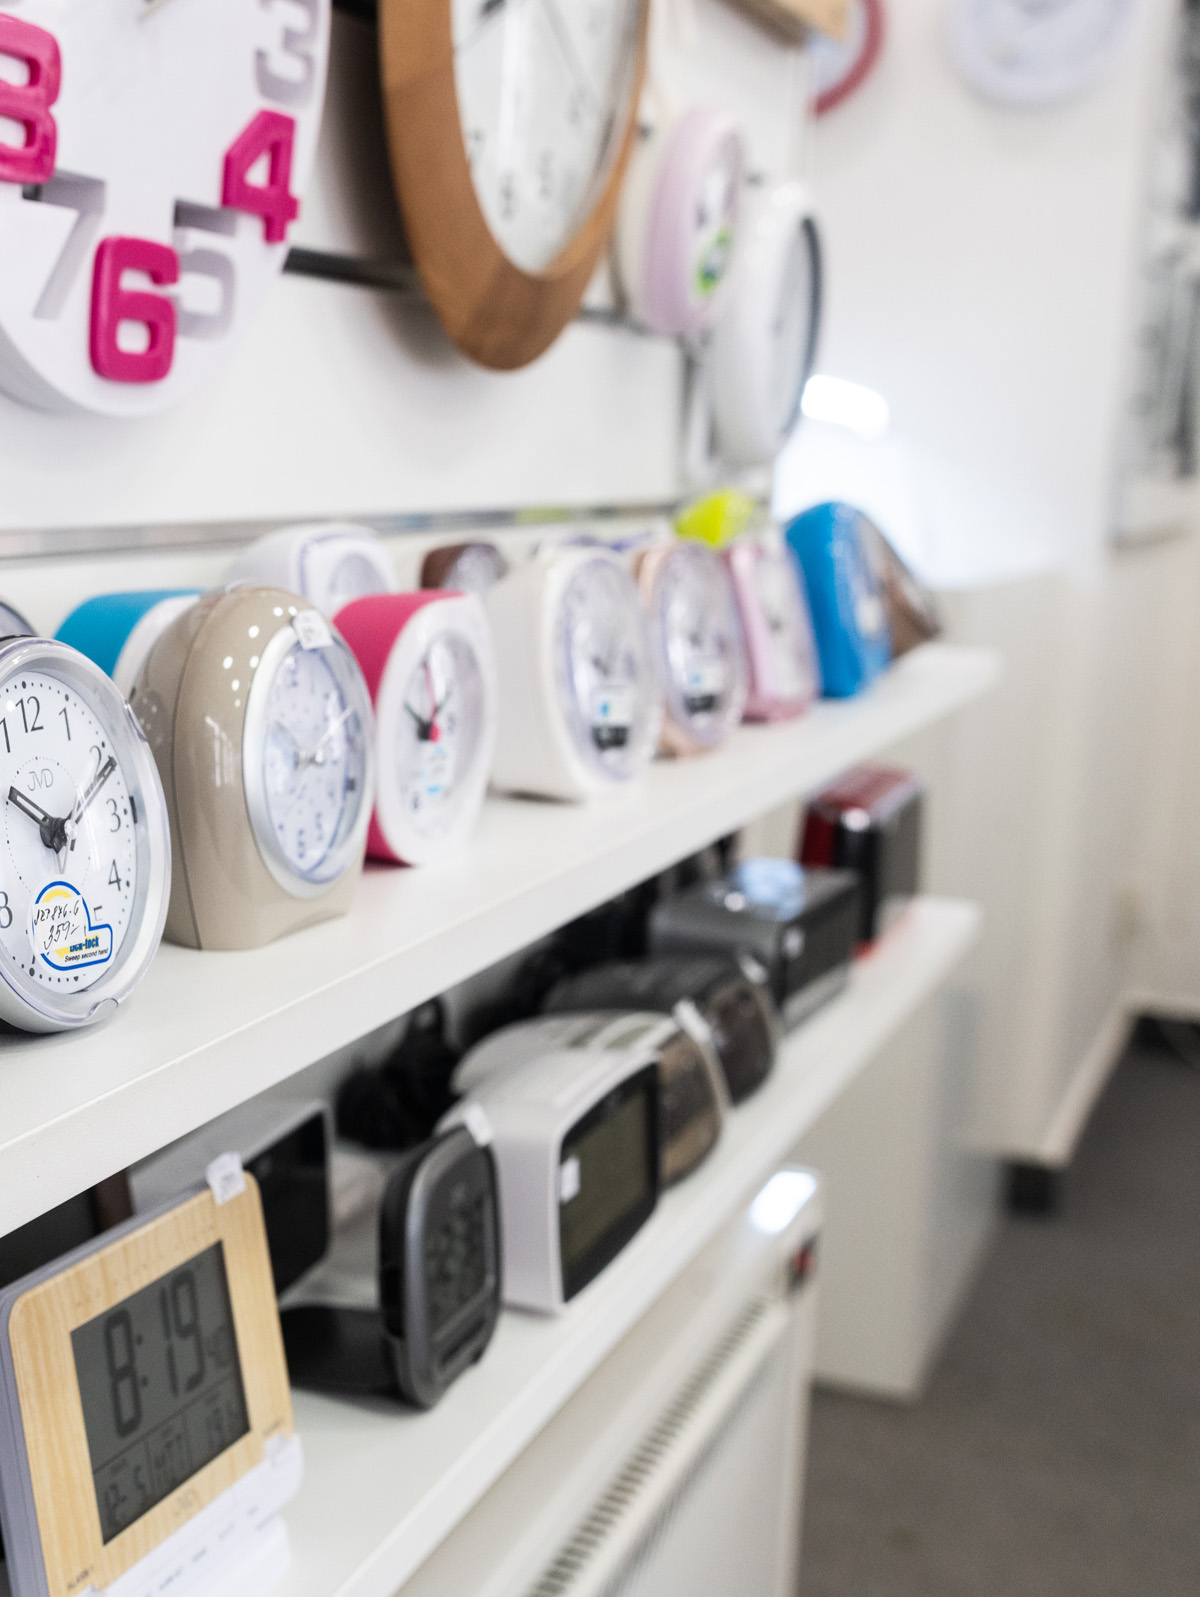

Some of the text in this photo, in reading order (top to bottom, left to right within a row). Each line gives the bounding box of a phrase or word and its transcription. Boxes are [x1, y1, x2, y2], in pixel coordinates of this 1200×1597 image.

[222, 108, 300, 245] 4
[90, 235, 180, 384] 6
[15, 696, 44, 733] 12
[58, 706, 72, 741] 1
[27, 768, 54, 792] JVD
[106, 798, 122, 833] 3
[107, 859, 122, 892] 4
[64, 948, 109, 963] Sweep second hand
[104, 1268, 205, 1440] 8:19
